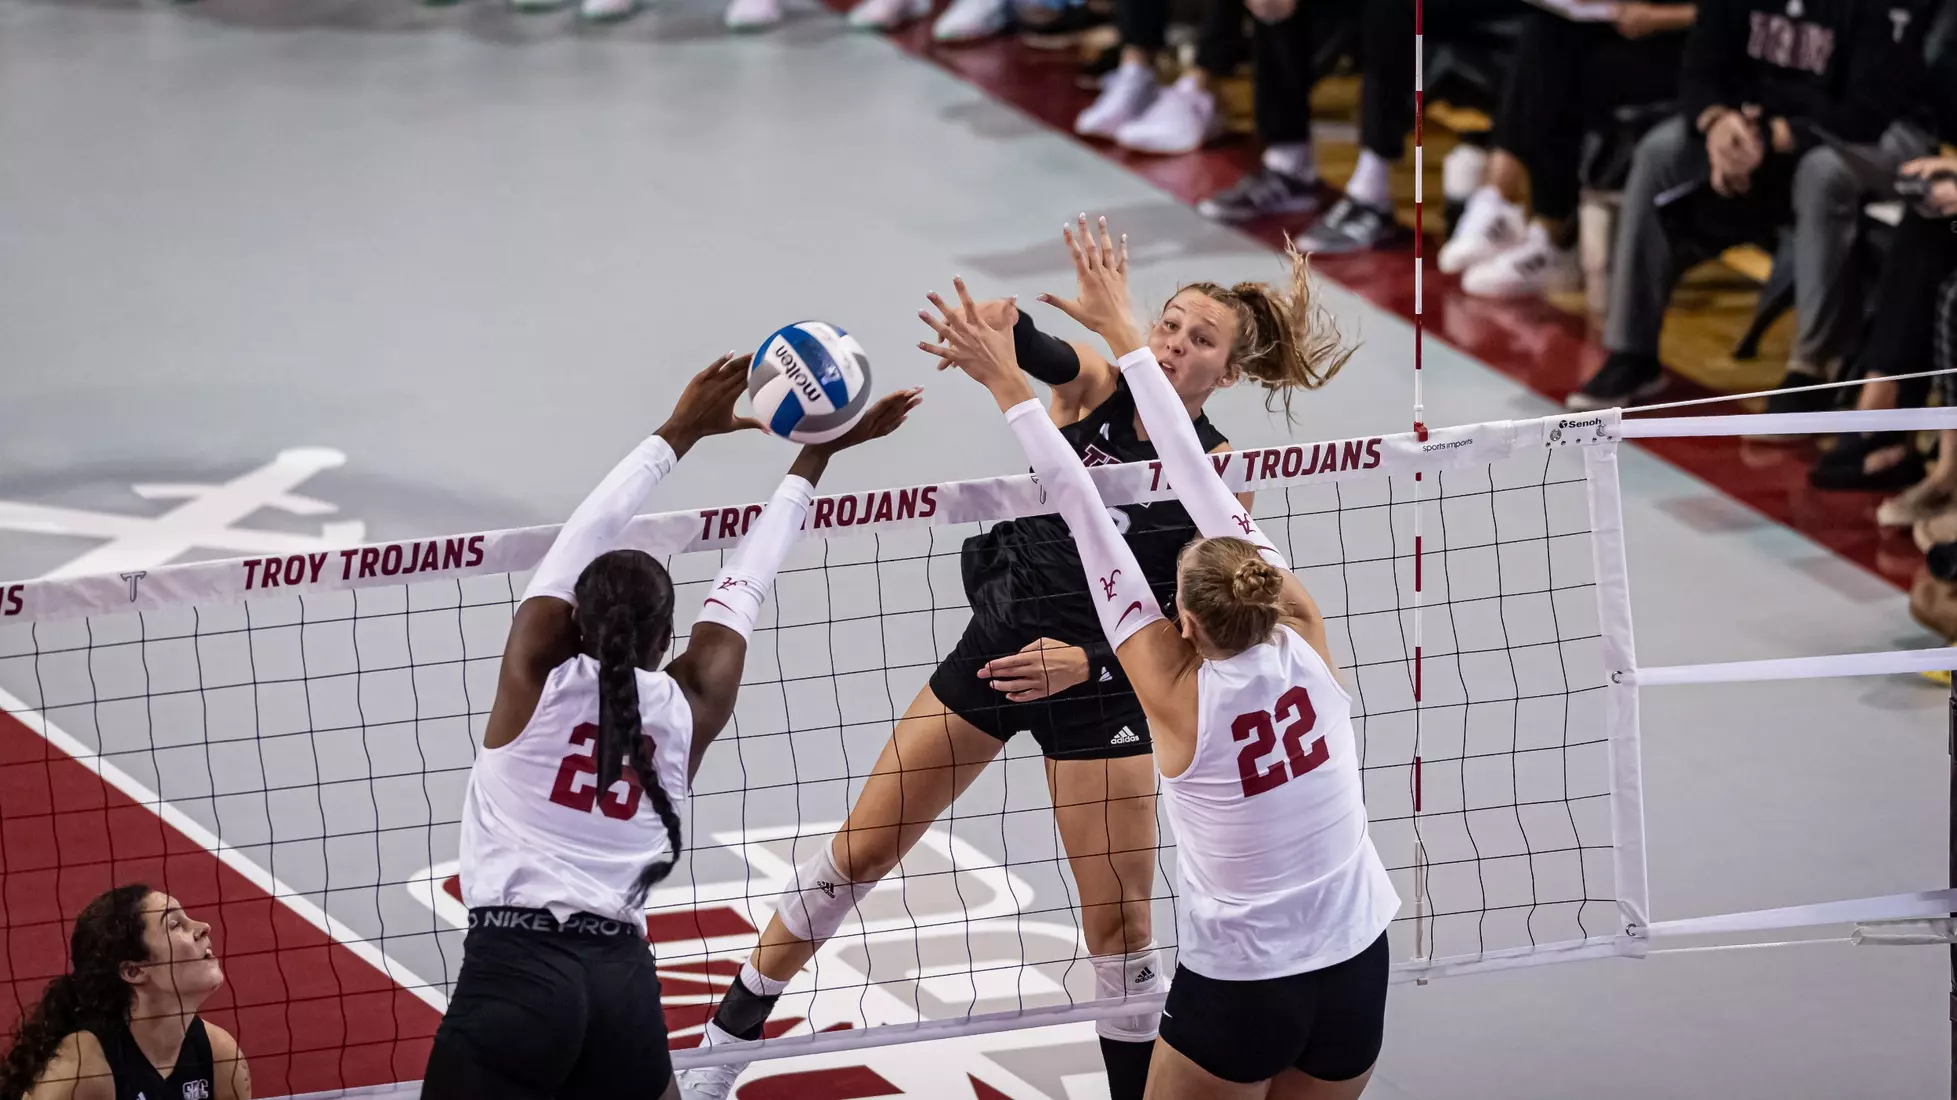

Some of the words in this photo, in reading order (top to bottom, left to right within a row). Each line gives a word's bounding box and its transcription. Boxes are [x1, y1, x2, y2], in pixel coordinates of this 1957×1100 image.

[775, 345, 821, 402] molten
[1568, 417, 1602, 428] Senoh
[1422, 443, 1446, 453] sports
[1446, 438, 1473, 449] imports
[1148, 453, 1232, 491] TY
[1242, 438, 1382, 482] TROJANS
[700, 503, 768, 540] TRO
[242, 552, 328, 590] TROY
[340, 535, 485, 580] TROJANS
[1110, 735, 1140, 744] adidas
[1231, 685, 1330, 798] 22
[483, 911, 551, 932] NIKE
[558, 917, 621, 936] PRO
